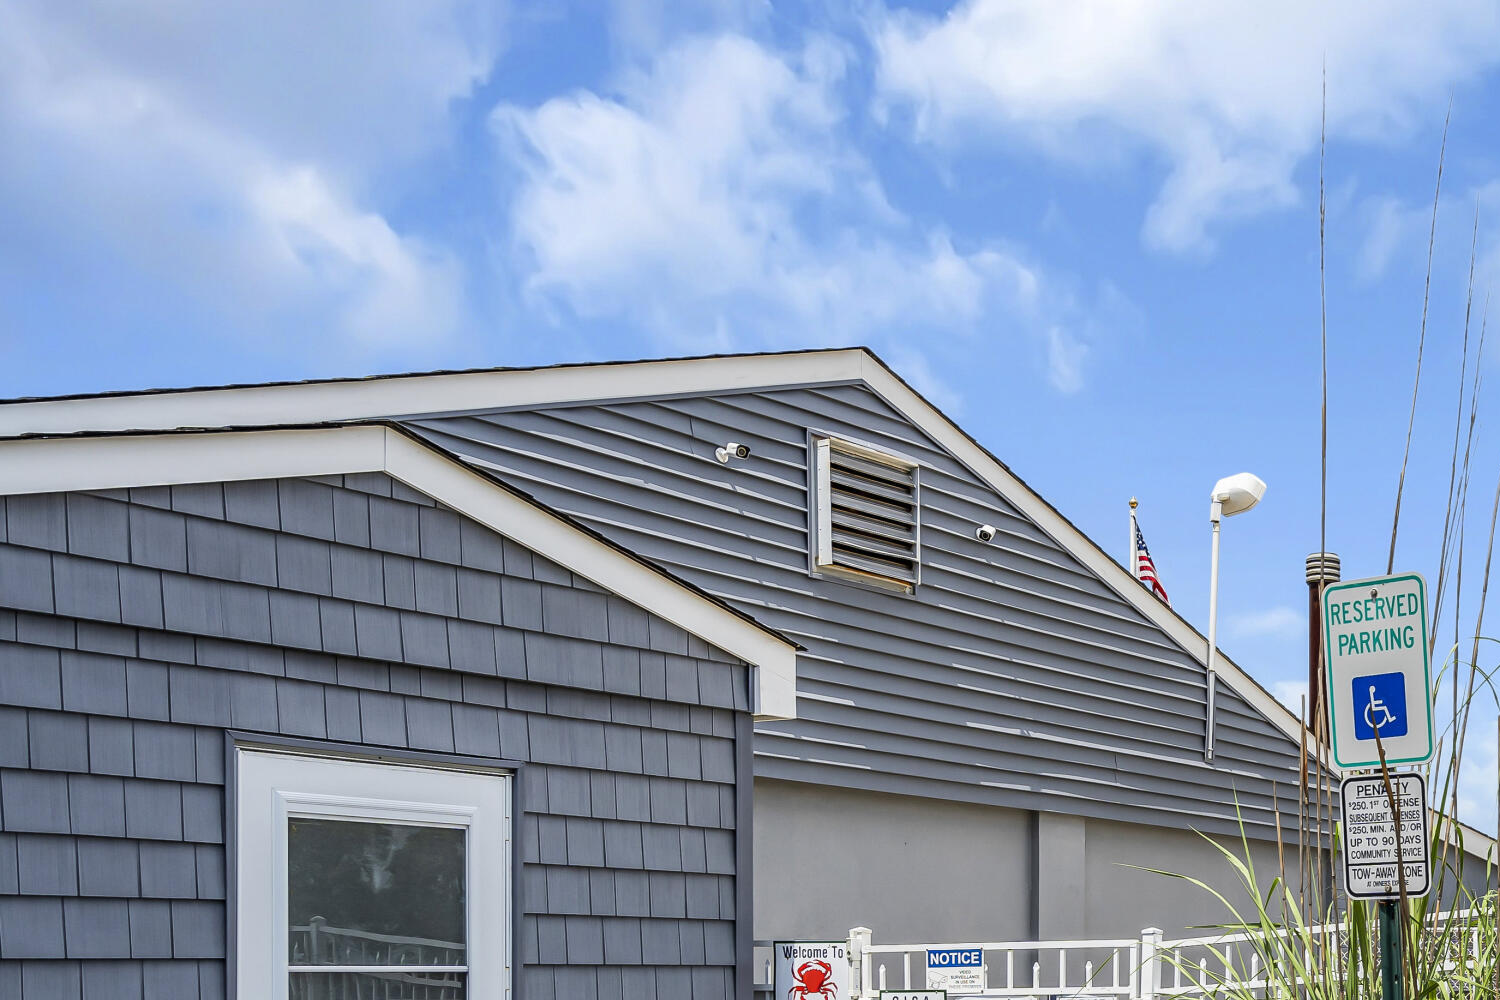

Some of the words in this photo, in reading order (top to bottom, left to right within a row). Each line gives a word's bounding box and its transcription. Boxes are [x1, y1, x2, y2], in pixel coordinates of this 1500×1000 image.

[1330, 593, 1418, 625] RESERVED
[1338, 625, 1414, 656] PARKING
[1356, 782, 1409, 797] PENAY
[1383, 797, 1419, 809] OENSE
[1349, 812, 1388, 823] SUBSEQUENT
[1390, 810, 1420, 821] OENSES
[1370, 825, 1386, 833] MIN.
[1389, 823, 1422, 833] AD/OR
[1350, 838, 1362, 847] UP
[1366, 837, 1378, 846] TO
[1382, 836, 1394, 846] 90
[1399, 835, 1421, 845] DAYS
[1350, 849, 1391, 860] COMMUNITY
[1393, 847, 1422, 858] SRVICE
[1352, 867, 1396, 880] TOW-AWAY
[1402, 865, 1423, 878] ONE
[782, 946, 828, 959] Welcome
[832, 946, 844, 959] To
[930, 952, 980, 965] NOTICE
